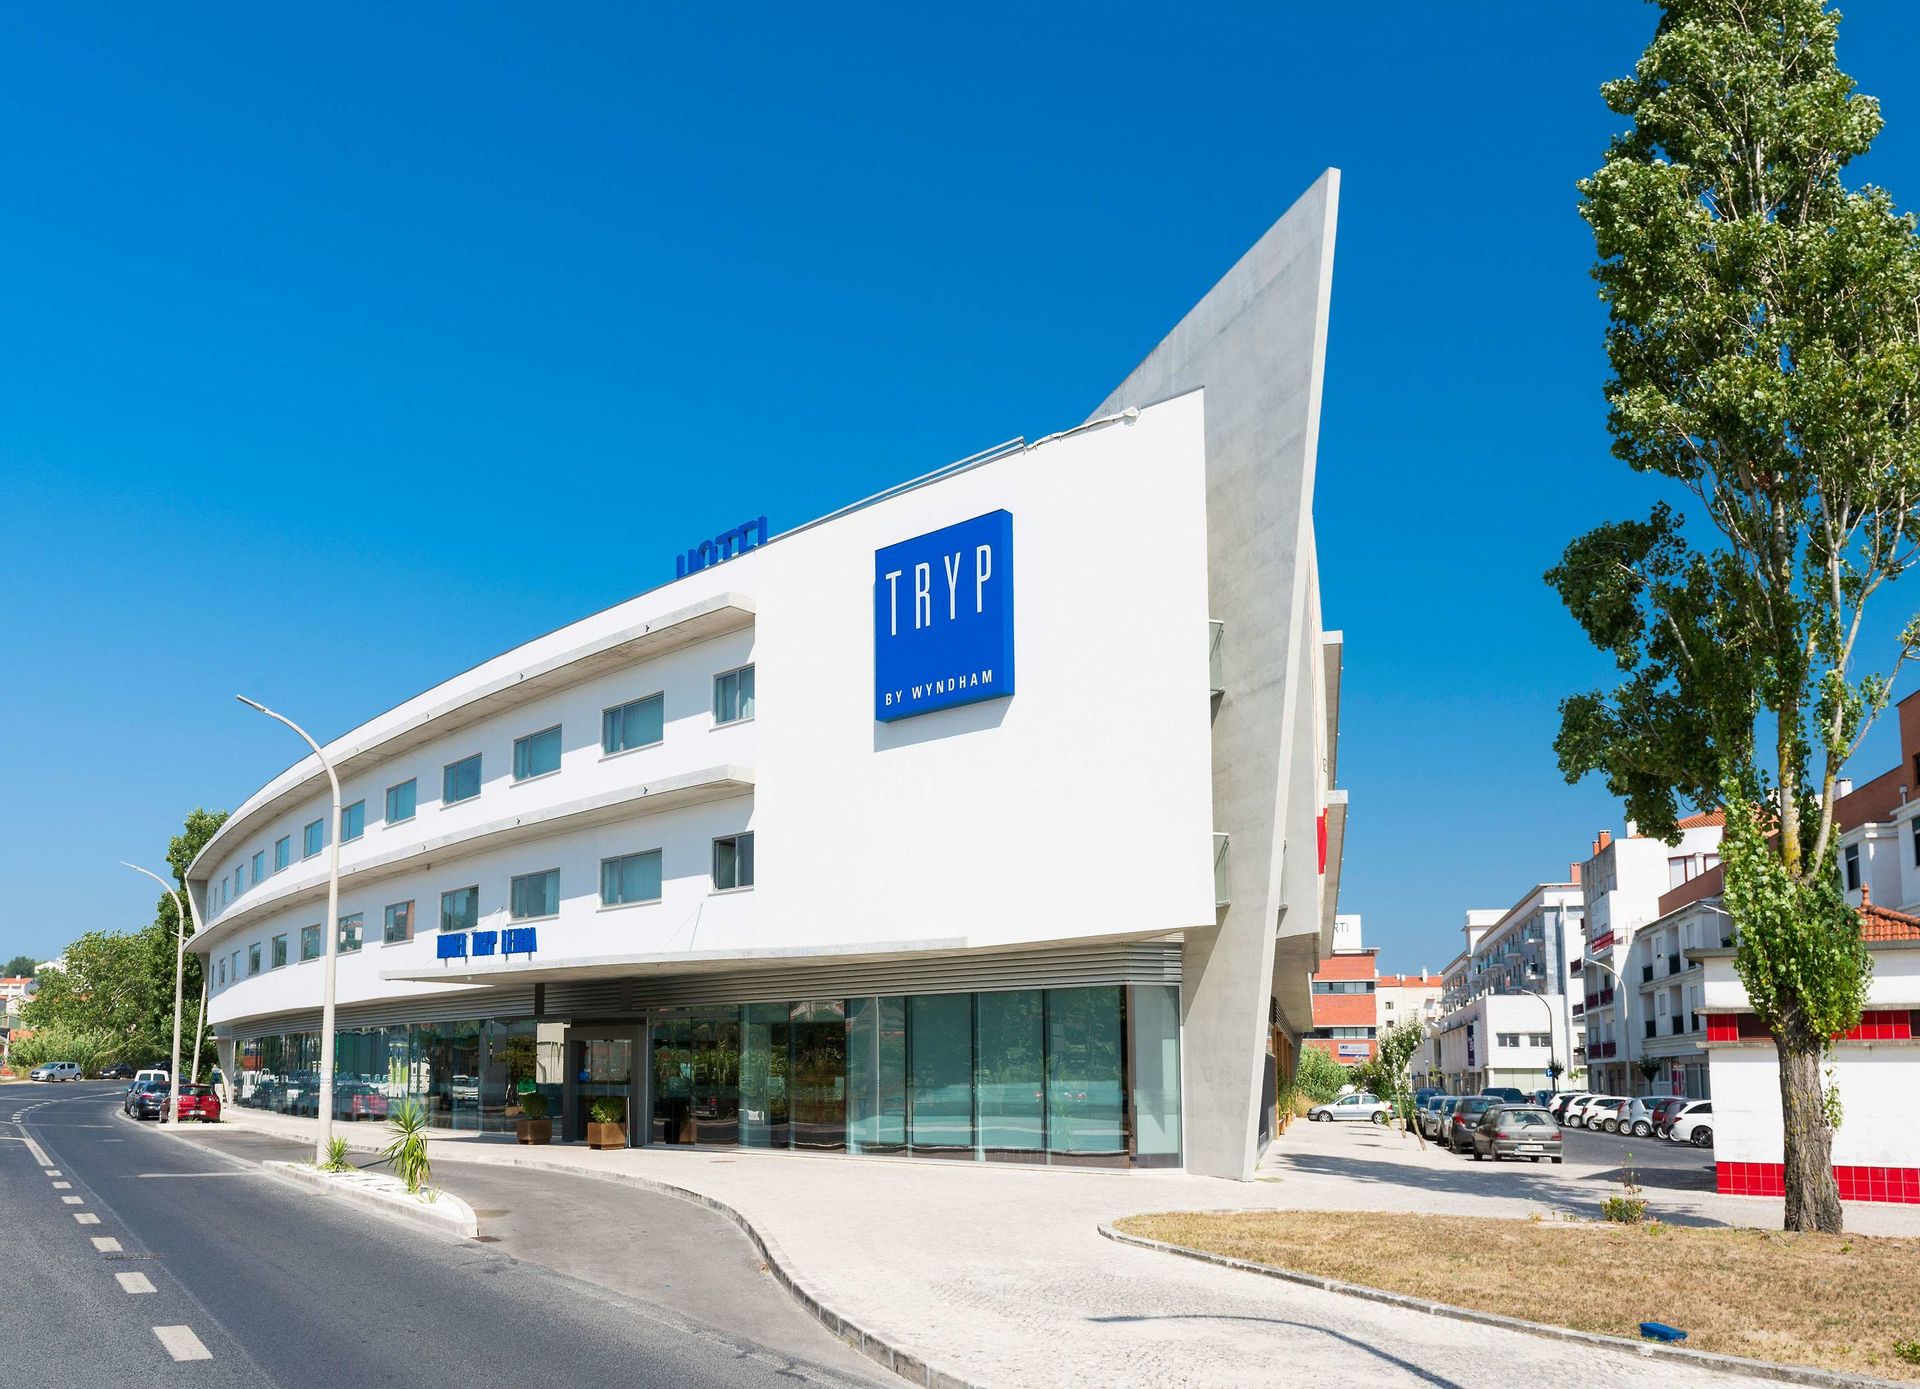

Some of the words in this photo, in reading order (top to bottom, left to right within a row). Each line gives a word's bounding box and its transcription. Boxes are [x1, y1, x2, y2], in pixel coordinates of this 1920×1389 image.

[885, 544, 992, 636] TRYP
[885, 690, 903, 706] BY
[912, 669, 993, 700] WYNDHAM
